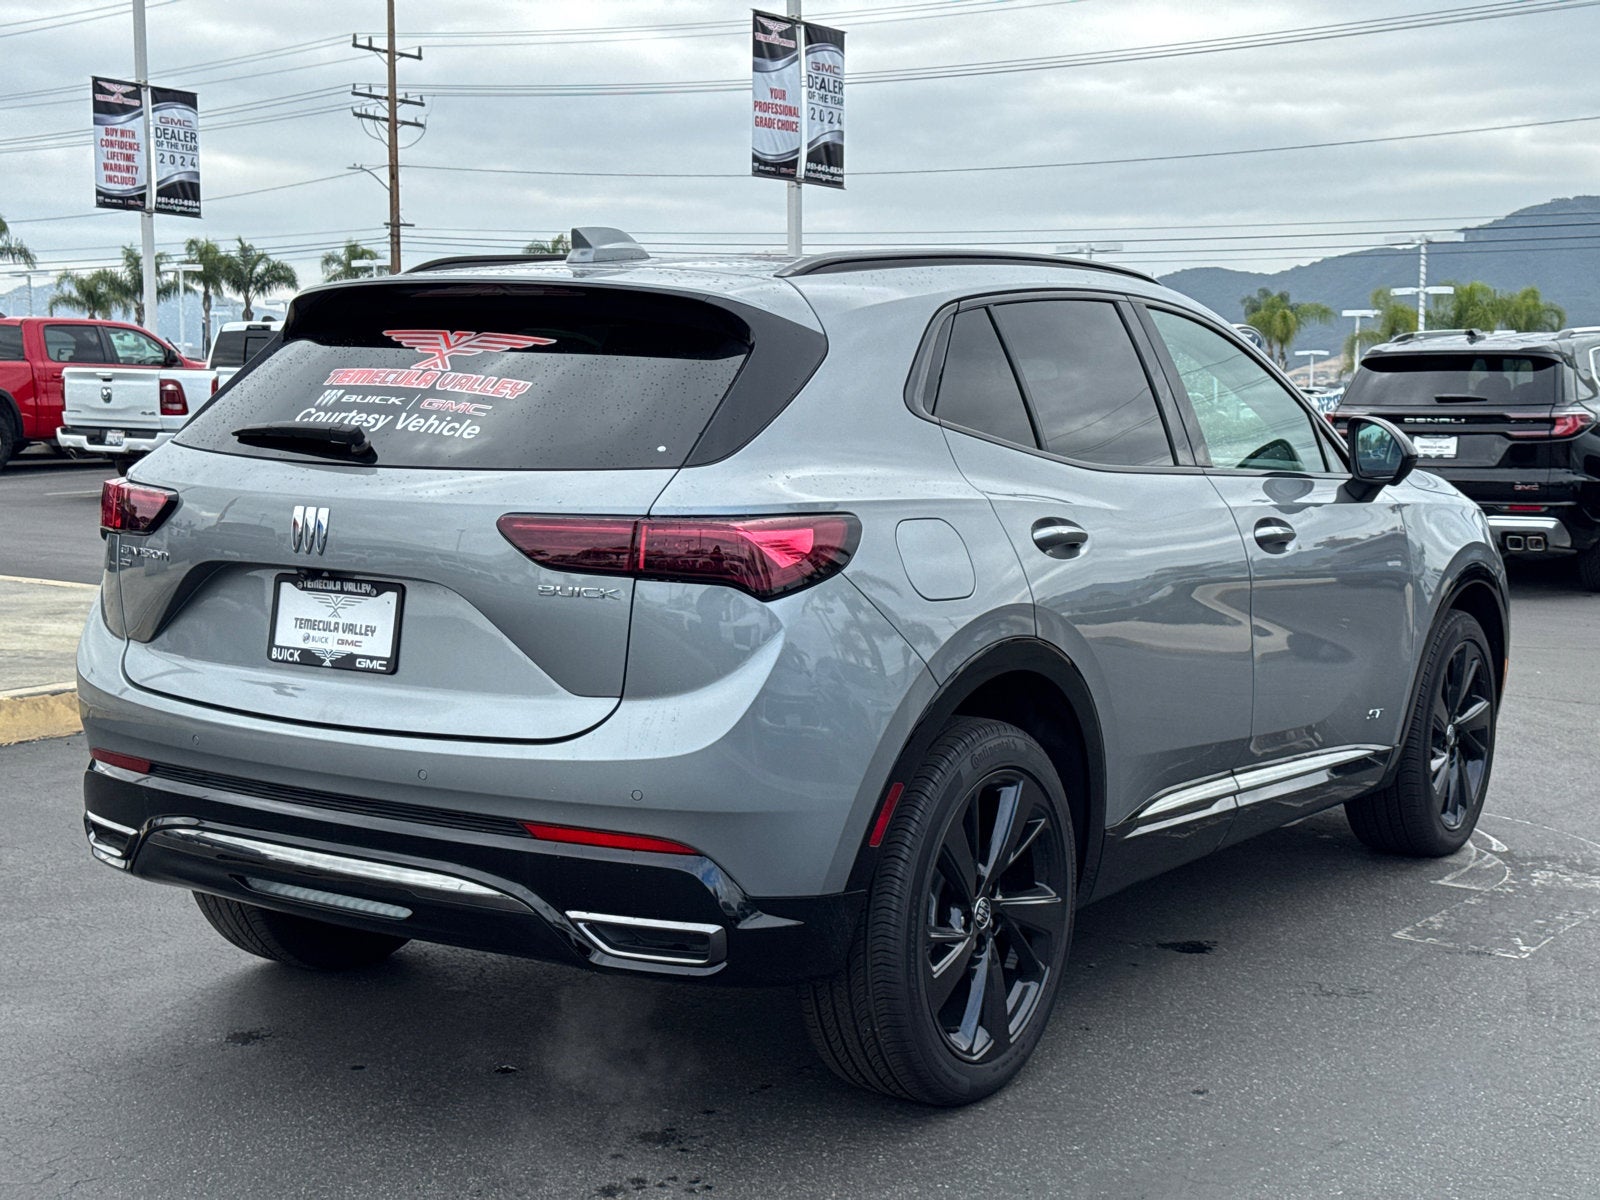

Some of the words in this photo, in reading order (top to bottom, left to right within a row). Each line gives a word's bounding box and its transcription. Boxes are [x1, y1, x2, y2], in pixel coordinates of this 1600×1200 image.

[811, 62, 840, 74] GMC
[808, 74, 844, 96] DEALER
[769, 87, 786, 100] YOUR
[808, 90, 816, 100] OF
[818, 92, 828, 103] THE
[830, 94, 844, 107] YEAR
[754, 100, 800, 118] PROFESSIONAL
[810, 107, 842, 126] 2024
[159, 116, 192, 128] GMC
[754, 116, 776, 130] GRADE
[777, 118, 799, 132] CHOICE
[104, 127, 118, 138] BUY
[120, 129, 136, 139] WITH
[155, 127, 198, 144] DEALER
[100, 138, 140, 152] CONFIDENCE
[156, 140, 164, 148] OF
[166, 142, 179, 150] THE
[181, 144, 198, 152] YEAR
[106, 151, 136, 162] LIFETIME
[160, 153, 196, 168] 2024
[103, 162, 139, 174] WARRANTY
[105, 174, 136, 186] INCLUDED
[323, 368, 441, 389] TEMECULA
[436, 370, 534, 400] VALLEY
[340, 394, 406, 406] BUICK
[420, 398, 493, 416] GMC
[295, 407, 394, 432] Courtesy
[396, 411, 481, 439] Vehicle
[304, 580, 341, 591] TEMECULA
[343, 582, 372, 594] VALLEY
[538, 584, 621, 601] BUICK
[294, 618, 340, 634] TEMECULA
[342, 623, 376, 637] VALLEY
[311, 635, 329, 644] BUICK
[336, 638, 363, 648] GMC
[272, 647, 302, 662] BUICK
[356, 658, 387, 670] GMC
